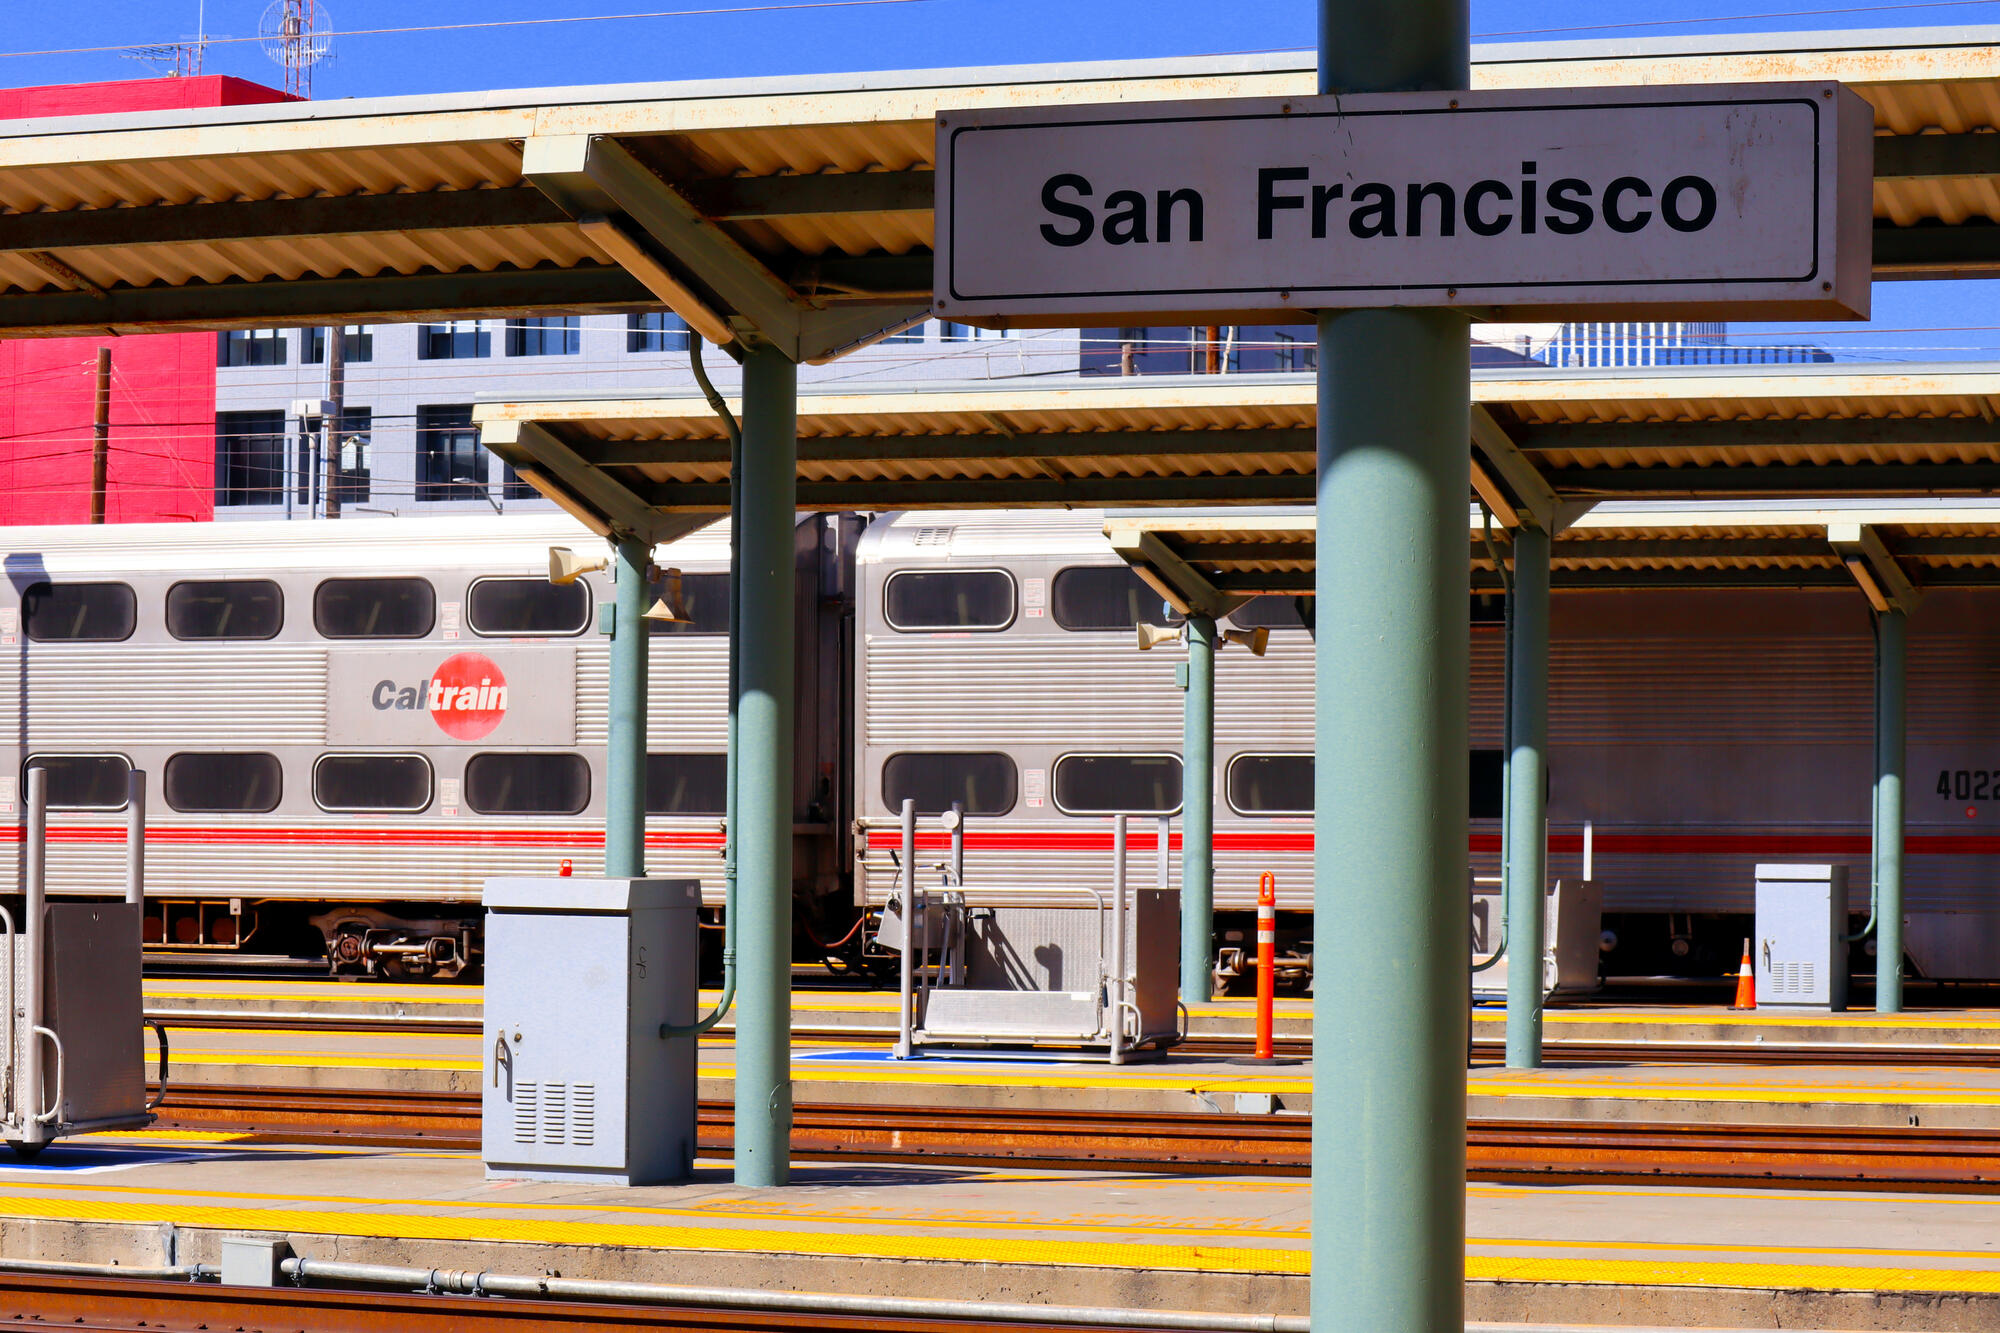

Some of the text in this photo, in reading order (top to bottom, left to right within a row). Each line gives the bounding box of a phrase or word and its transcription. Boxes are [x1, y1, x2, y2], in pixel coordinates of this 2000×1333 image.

[1039, 160, 1717, 248] San Francisco
[372, 677, 509, 711] Caltrain
